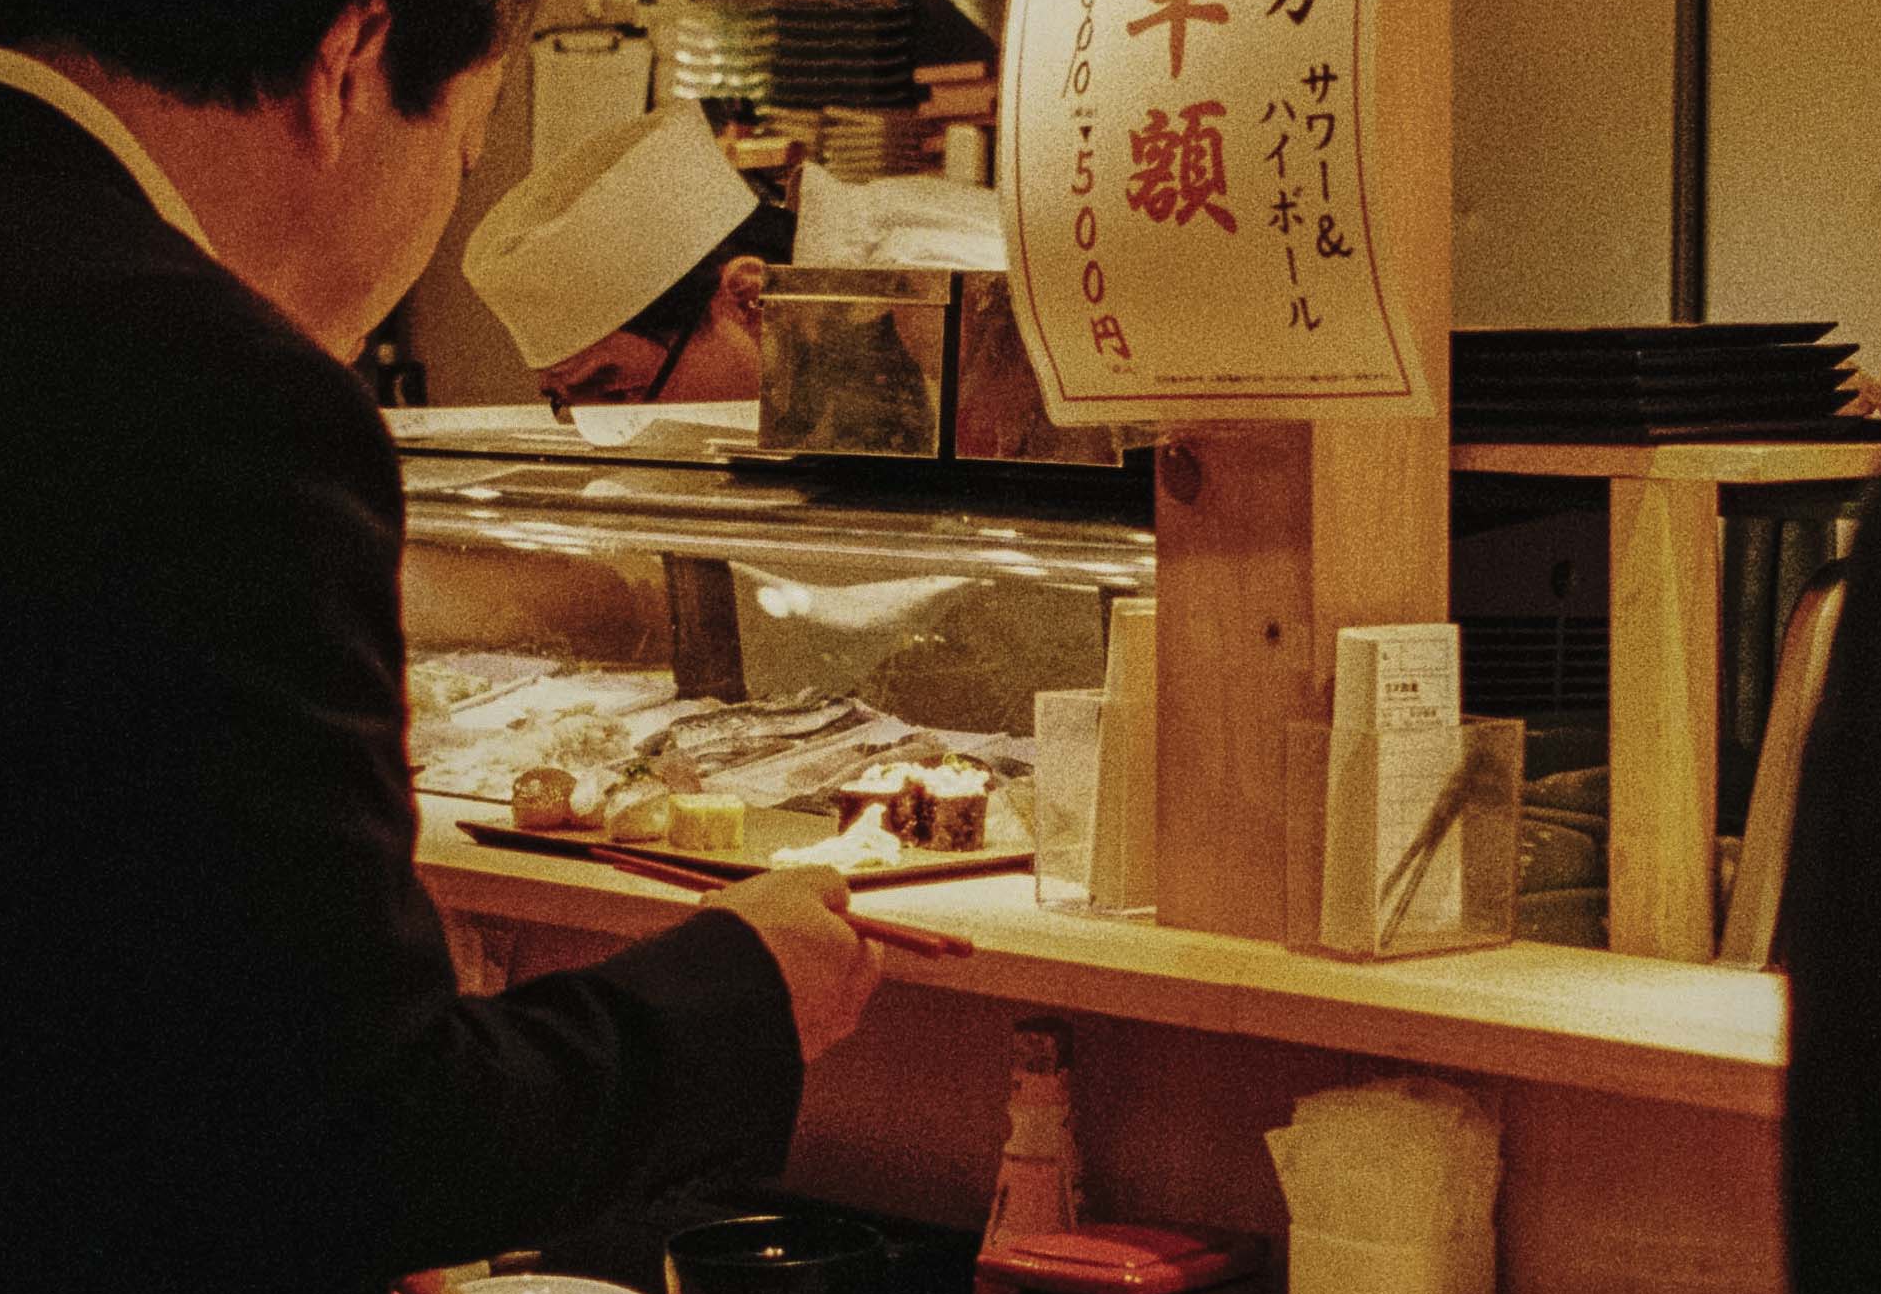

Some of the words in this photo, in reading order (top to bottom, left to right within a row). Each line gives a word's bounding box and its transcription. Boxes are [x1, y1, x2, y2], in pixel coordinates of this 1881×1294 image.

[1070, 149, 1132, 361] 500円
[1258, 98, 1321, 332] ハイボール
